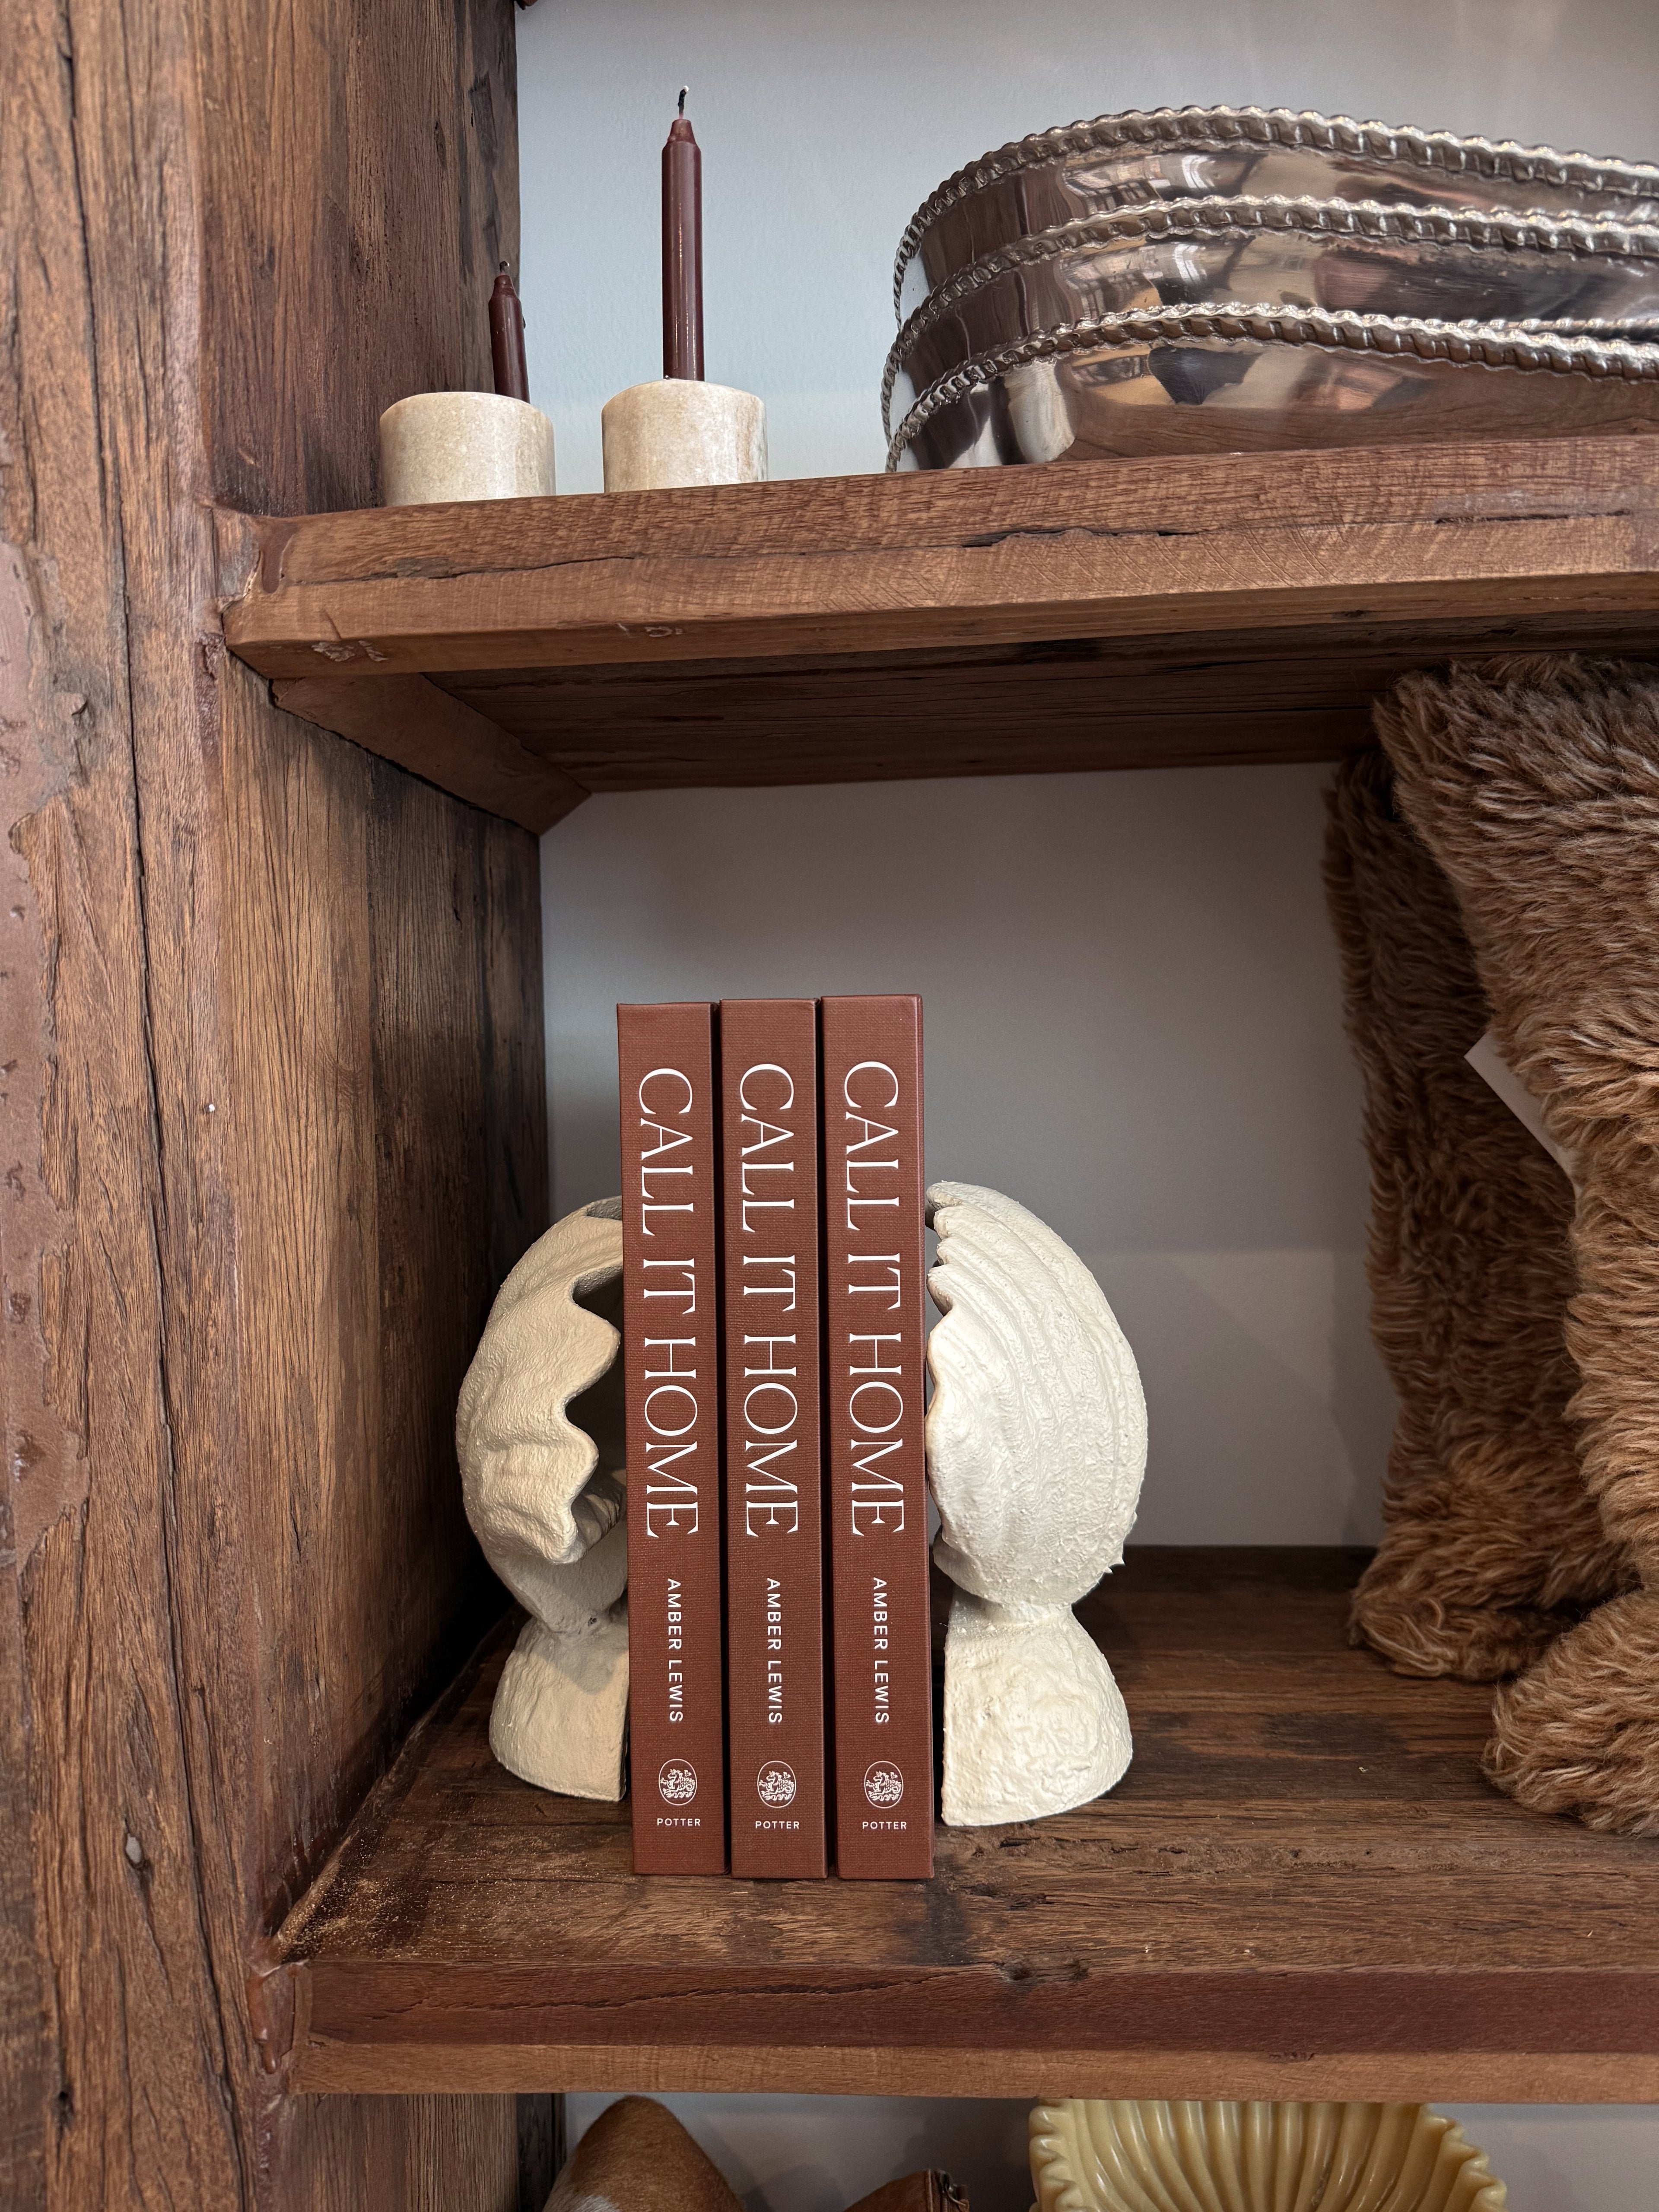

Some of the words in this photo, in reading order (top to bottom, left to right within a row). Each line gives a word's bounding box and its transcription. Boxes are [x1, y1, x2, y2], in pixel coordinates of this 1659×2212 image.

[639, 1068, 694, 1236] CALL
[739, 1063, 795, 1233] CALL
[844, 1061, 899, 1231] CALL
[642, 1258, 696, 1315] IT
[743, 1255, 796, 1312] IT
[848, 1253, 901, 1310] IT
[644, 1336, 699, 1538] HOME
[744, 1334, 798, 1538] HOME
[849, 1332, 904, 1536] HOME
[667, 1578, 682, 1649] AMBER
[767, 1578, 782, 1650] AMBER
[873, 1577, 888, 1649] AMBER
[668, 1660, 683, 1722] LEWIS
[768, 1660, 782, 1723] LEWIS
[874, 1660, 890, 1724] LEWIS
[657, 1818, 700, 1826] POTTER
[755, 1821, 800, 1829] POTTER
[862, 1821, 907, 1830] POTTER
